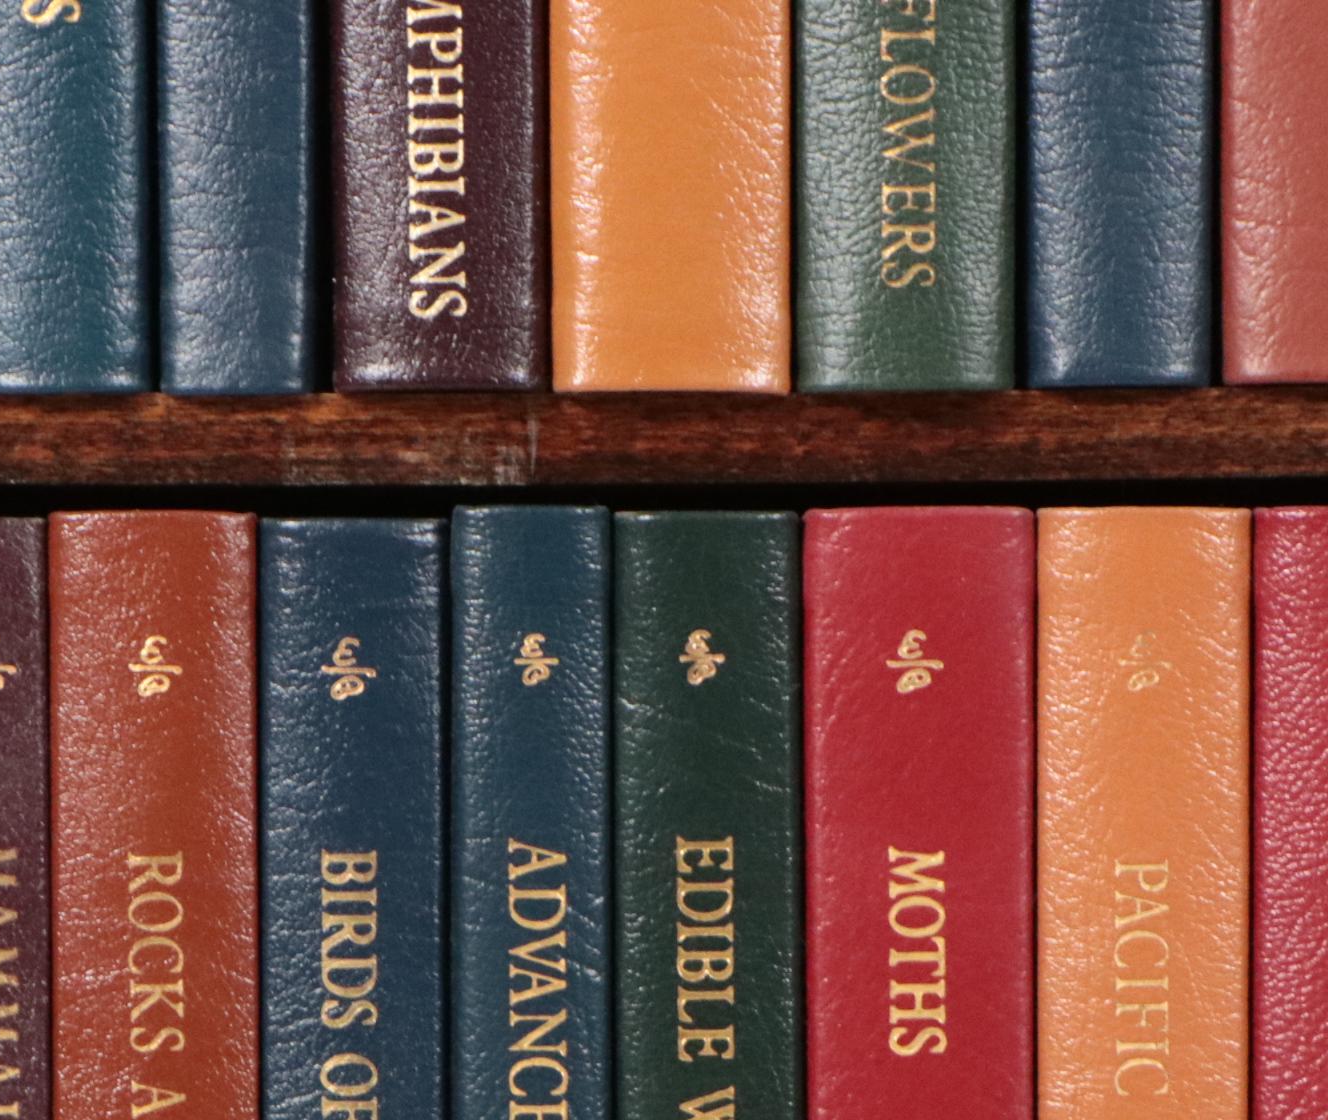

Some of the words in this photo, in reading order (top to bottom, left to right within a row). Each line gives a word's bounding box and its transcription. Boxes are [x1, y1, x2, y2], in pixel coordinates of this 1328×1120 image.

[127, 851, 185, 1054] ROCKS
[320, 849, 378, 1030] BIRDS
[675, 835, 735, 1063] EDIBLE
[888, 845, 947, 1058] MOTHS
[1113, 858, 1170, 1097] PACIFIC
